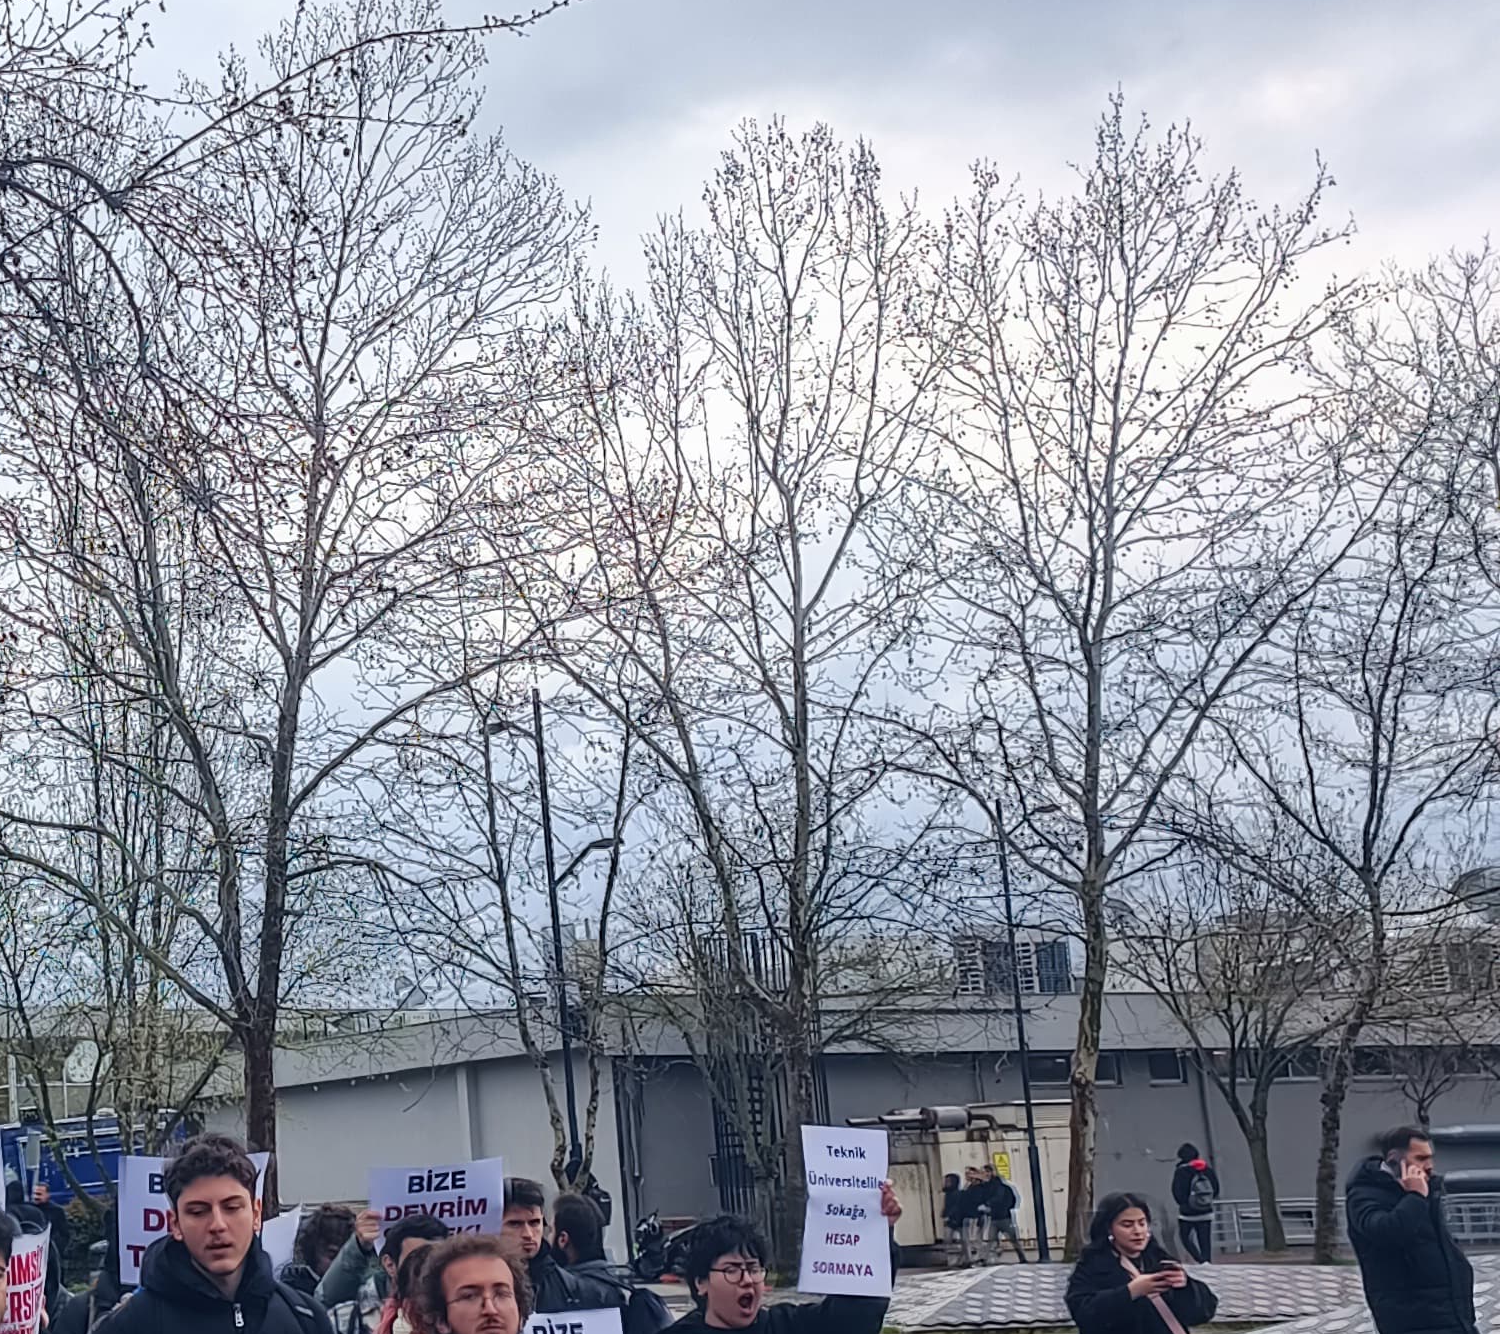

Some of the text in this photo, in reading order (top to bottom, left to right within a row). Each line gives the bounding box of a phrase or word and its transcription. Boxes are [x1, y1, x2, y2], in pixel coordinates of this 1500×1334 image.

[826, 1145, 867, 1159] Teknik
[408, 1169, 467, 1194] BİZE
[808, 1170, 884, 1191] Üniversitelile
[384, 1196, 488, 1221] DEVRİM
[825, 1232, 860, 1246] HESAP
[812, 1261, 874, 1277] SORMAYA
